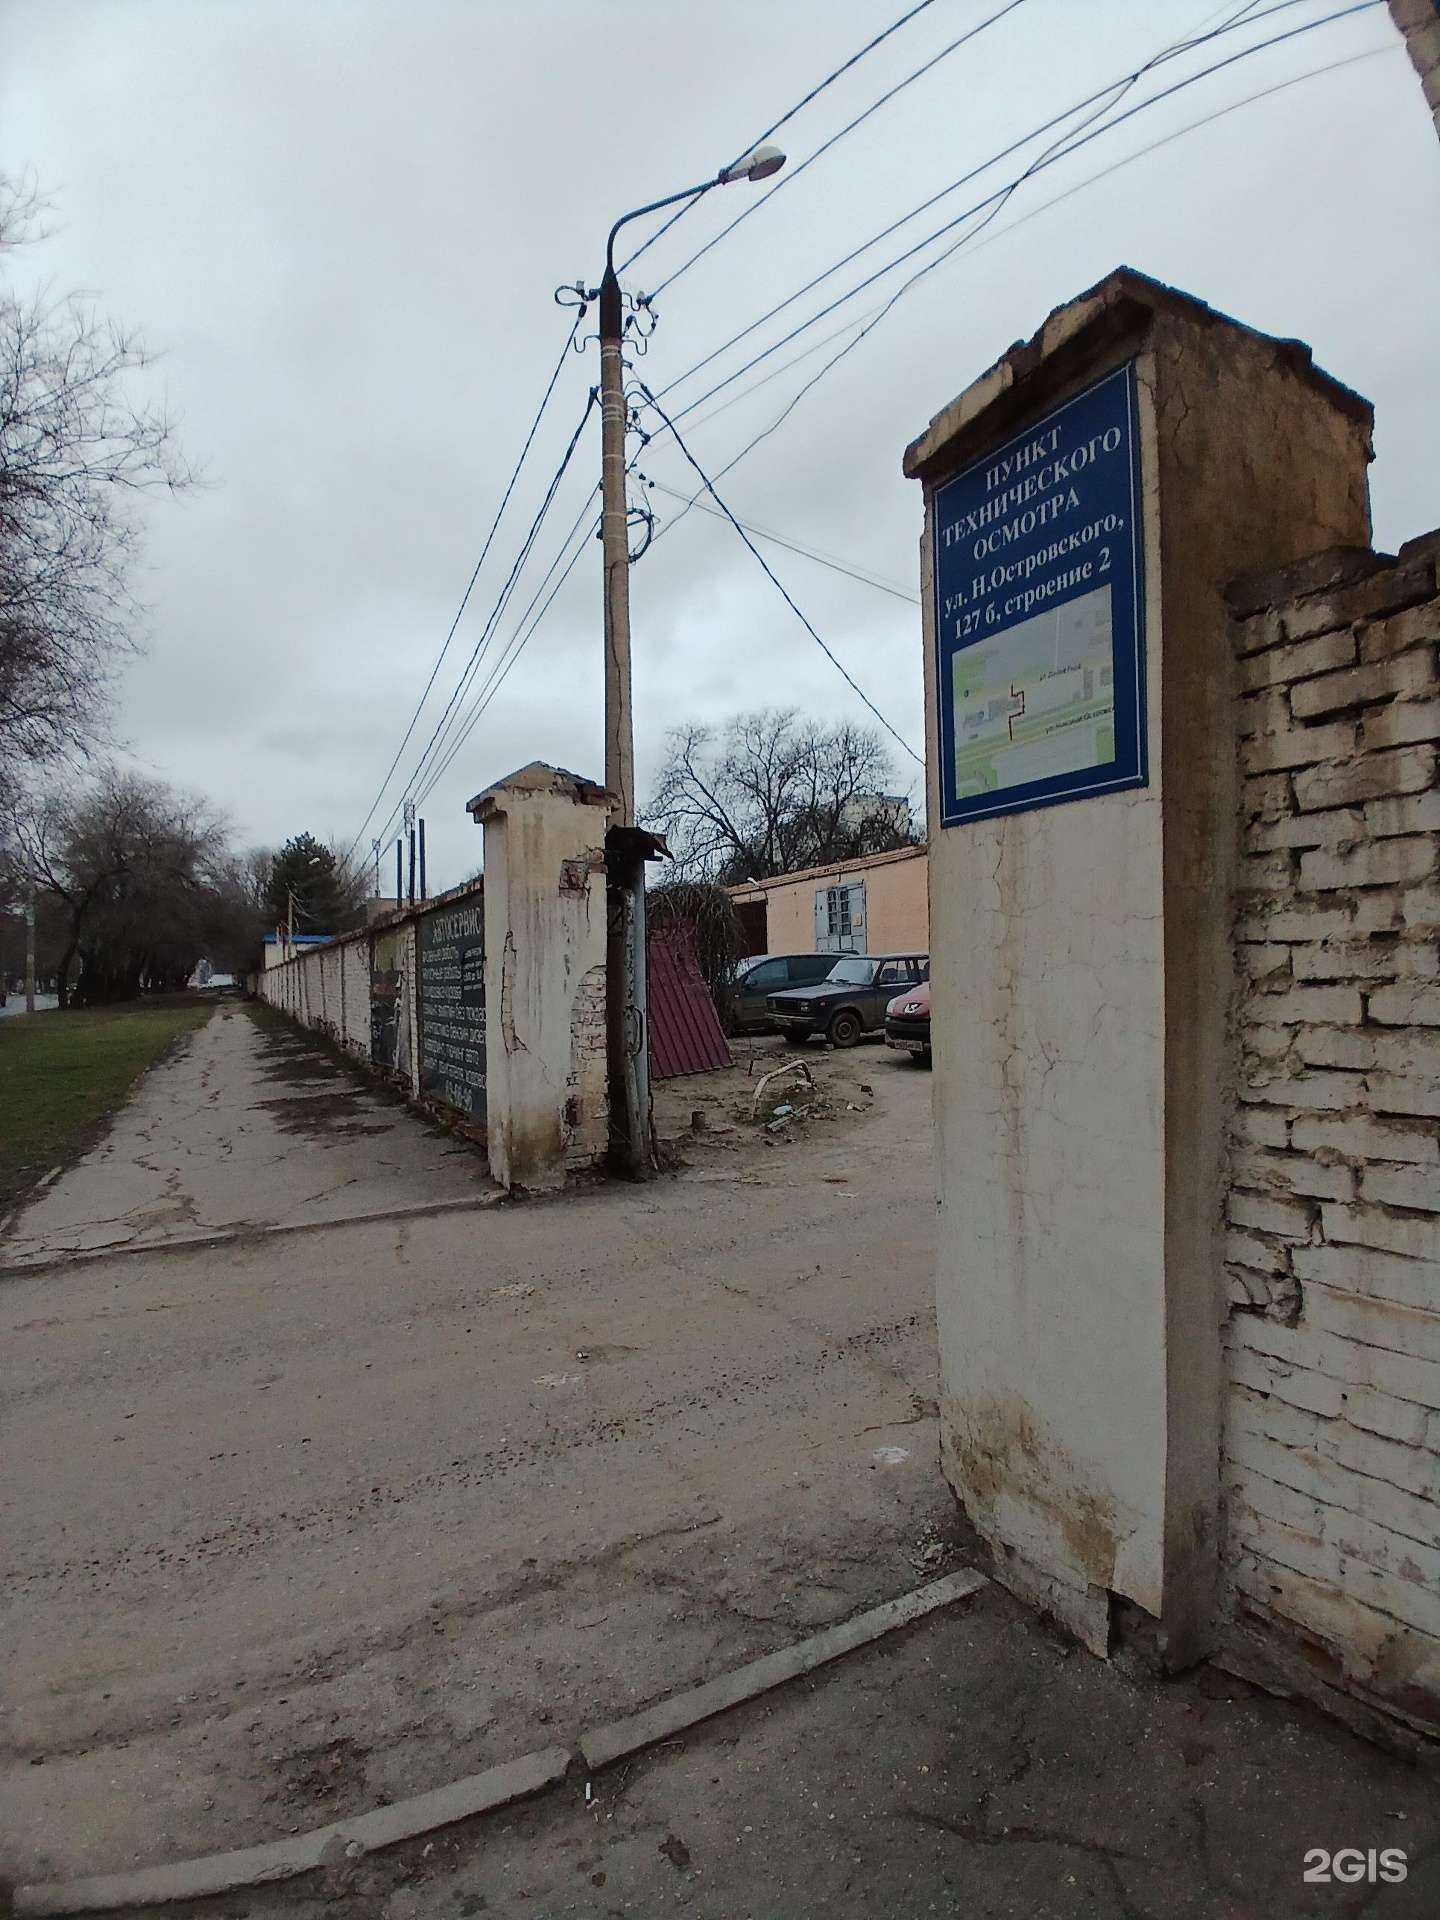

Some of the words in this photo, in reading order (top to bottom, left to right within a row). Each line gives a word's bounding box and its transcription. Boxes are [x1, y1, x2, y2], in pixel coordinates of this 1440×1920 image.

[942, 426, 1122, 548] ТЕХНИЧЕСКОГО
[985, 425, 1062, 493] ПУНКТ
[973, 486, 1081, 561] ОСМОТРА
[944, 591, 969, 619] ул.
[971, 513, 1125, 600] Н.Островского,
[955, 608, 981, 640] 127
[984, 600, 1001, 625] б,
[1004, 560, 1094, 615] строение
[1098, 547, 1112, 573] 2
[432, 907, 481, 943] АВТОСЕРВИС
